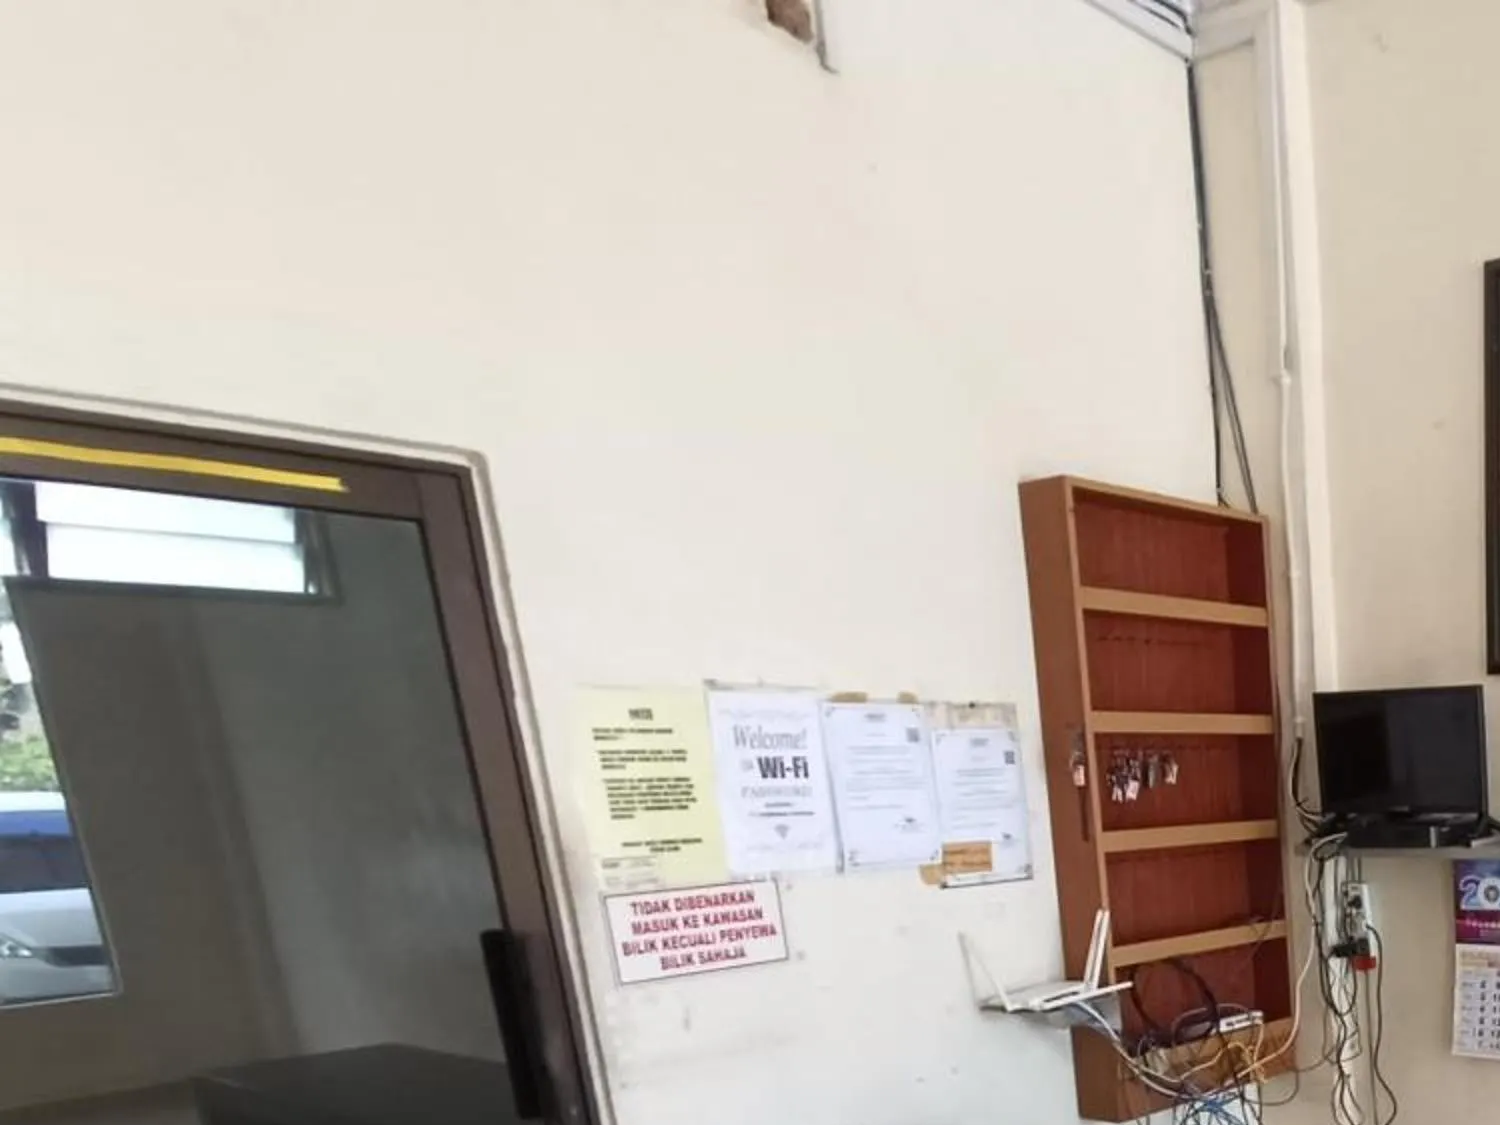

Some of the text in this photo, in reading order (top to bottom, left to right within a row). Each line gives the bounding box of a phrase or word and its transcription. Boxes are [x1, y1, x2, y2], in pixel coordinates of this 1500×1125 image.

[757, 756, 809, 779] Wi-Fi
[630, 890, 755, 916] TIDAK DIBENARKAN
[631, 908, 763, 935] MASUK KE KAWASAN
[622, 924, 777, 956] BILIK KECUALI PENYEWA
[660, 946, 747, 970] BILIK SAHAJA
